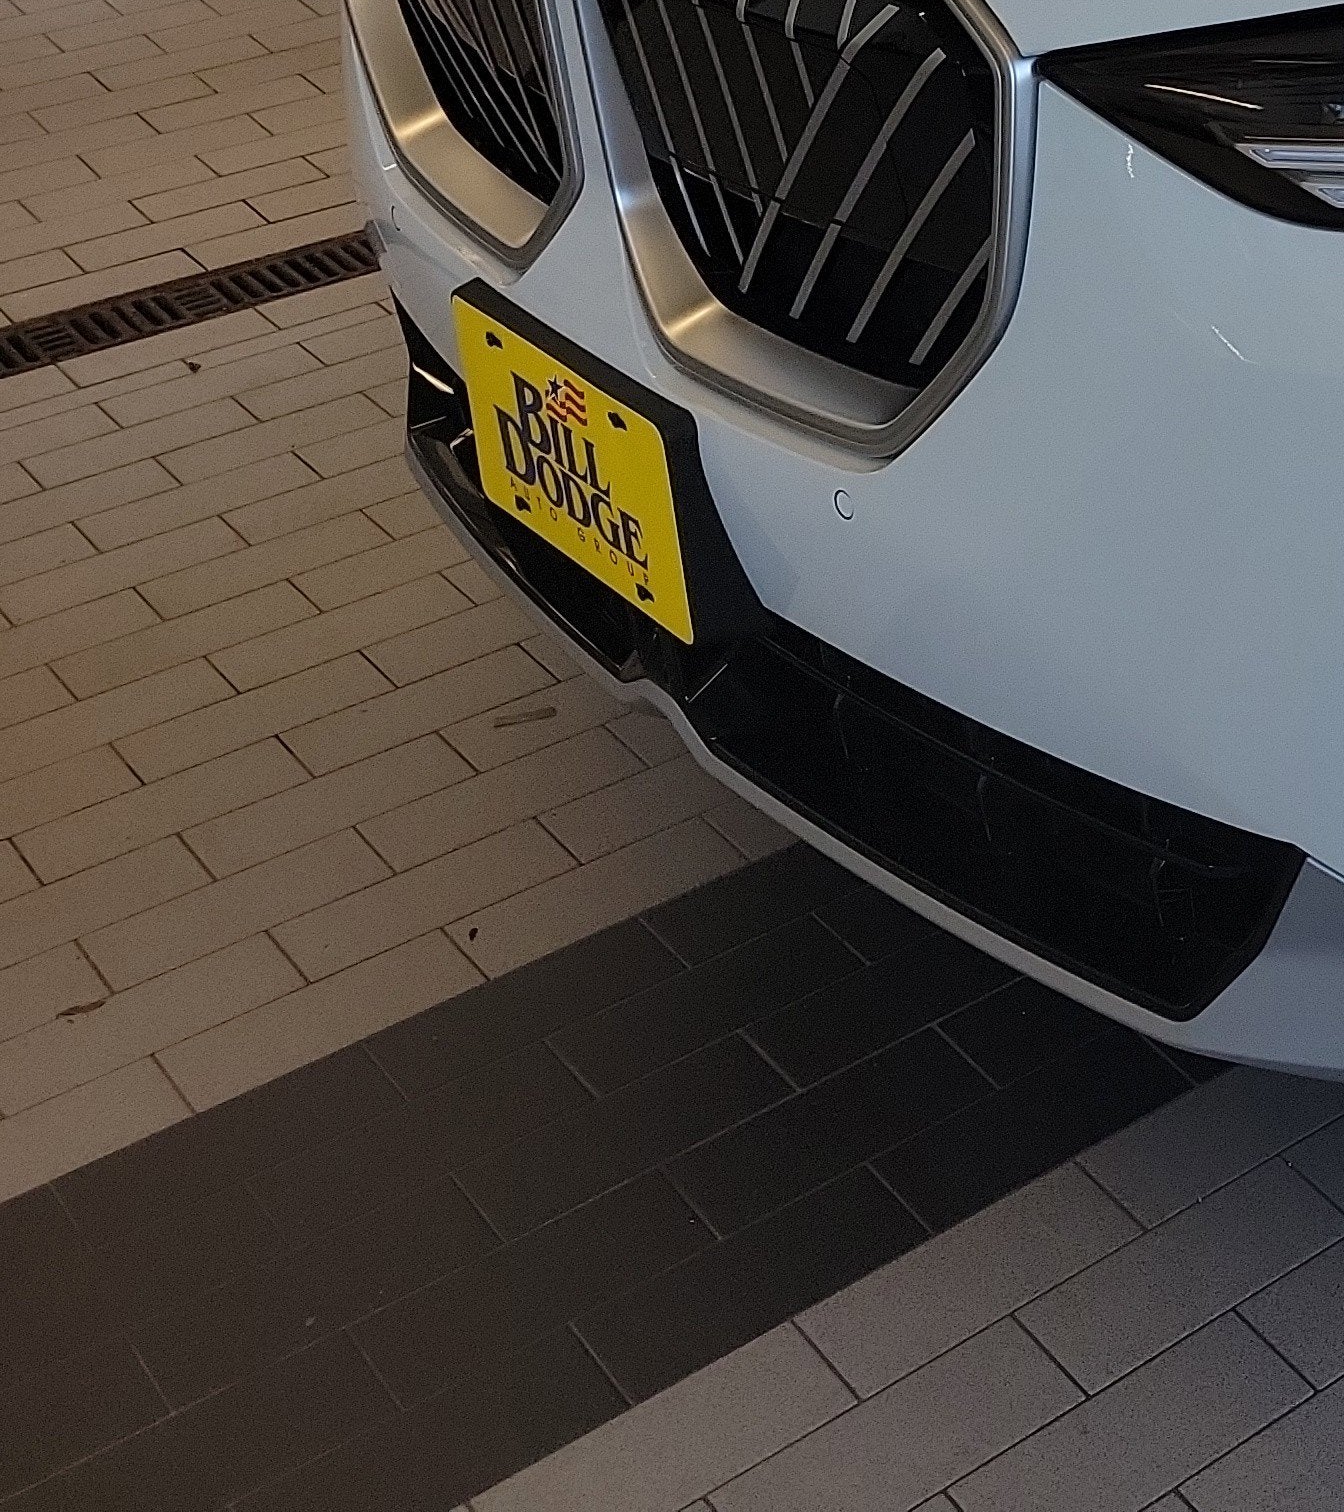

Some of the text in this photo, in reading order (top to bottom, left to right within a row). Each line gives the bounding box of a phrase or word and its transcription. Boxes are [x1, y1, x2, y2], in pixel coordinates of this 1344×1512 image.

[494, 405, 650, 570] DODGE
[510, 370, 611, 498] BILL
[510, 476, 651, 586] AUTO GROUP
